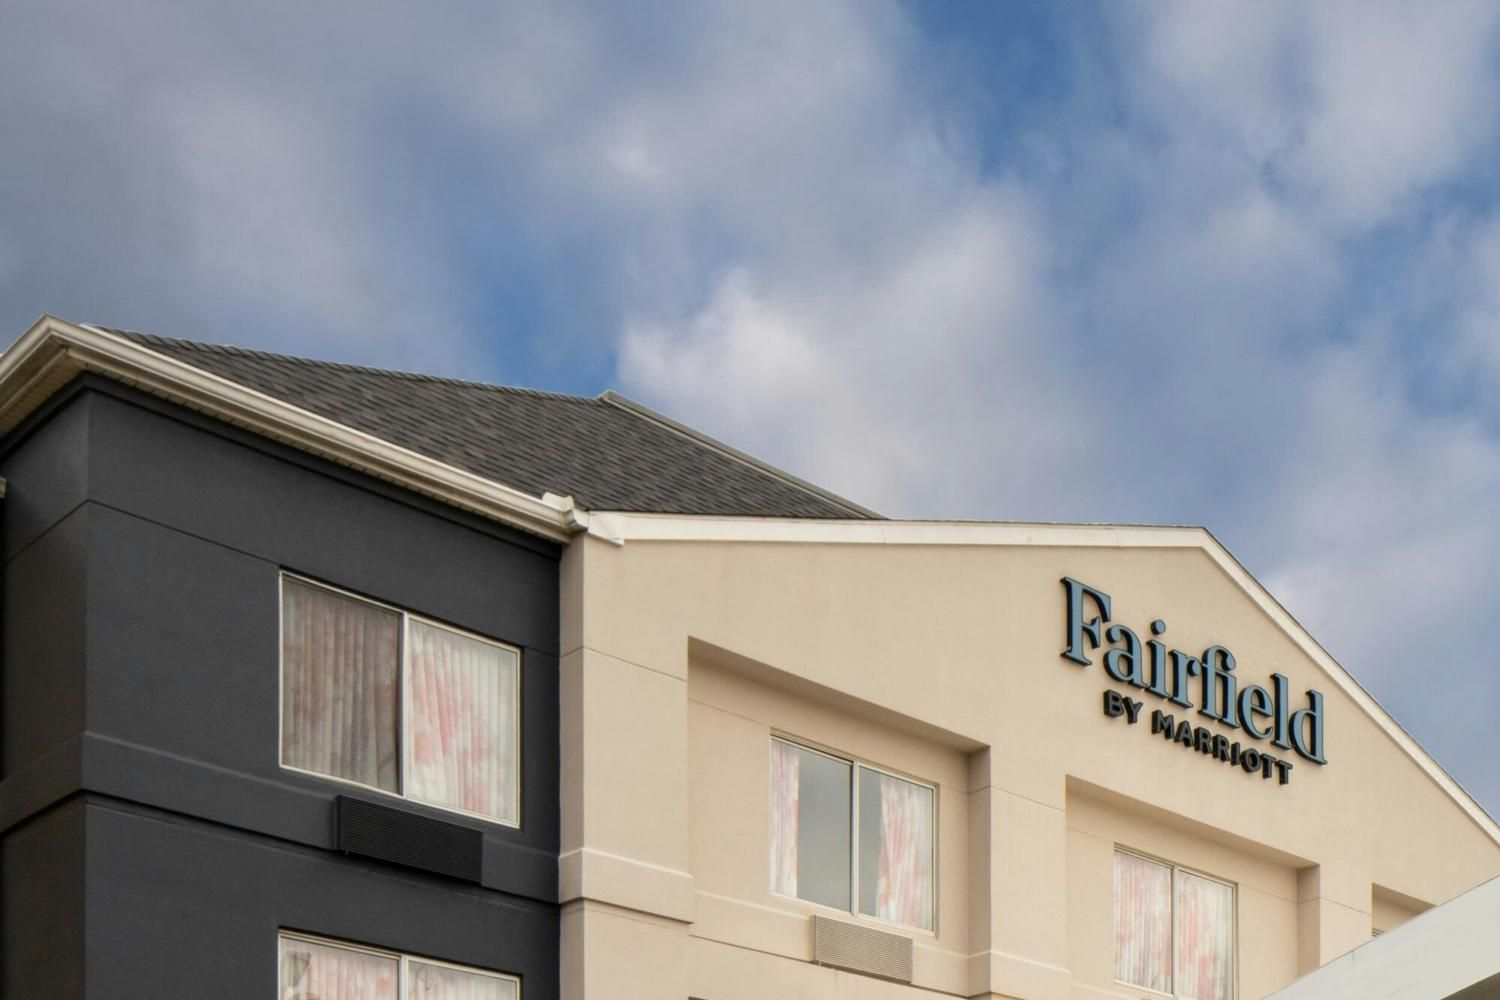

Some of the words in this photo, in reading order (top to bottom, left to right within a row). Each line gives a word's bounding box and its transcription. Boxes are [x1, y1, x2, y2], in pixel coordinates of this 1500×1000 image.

[1060, 576, 1328, 765] Fairfield
[1103, 689, 1143, 724] BY
[1151, 709, 1293, 785] MARRIOTT
